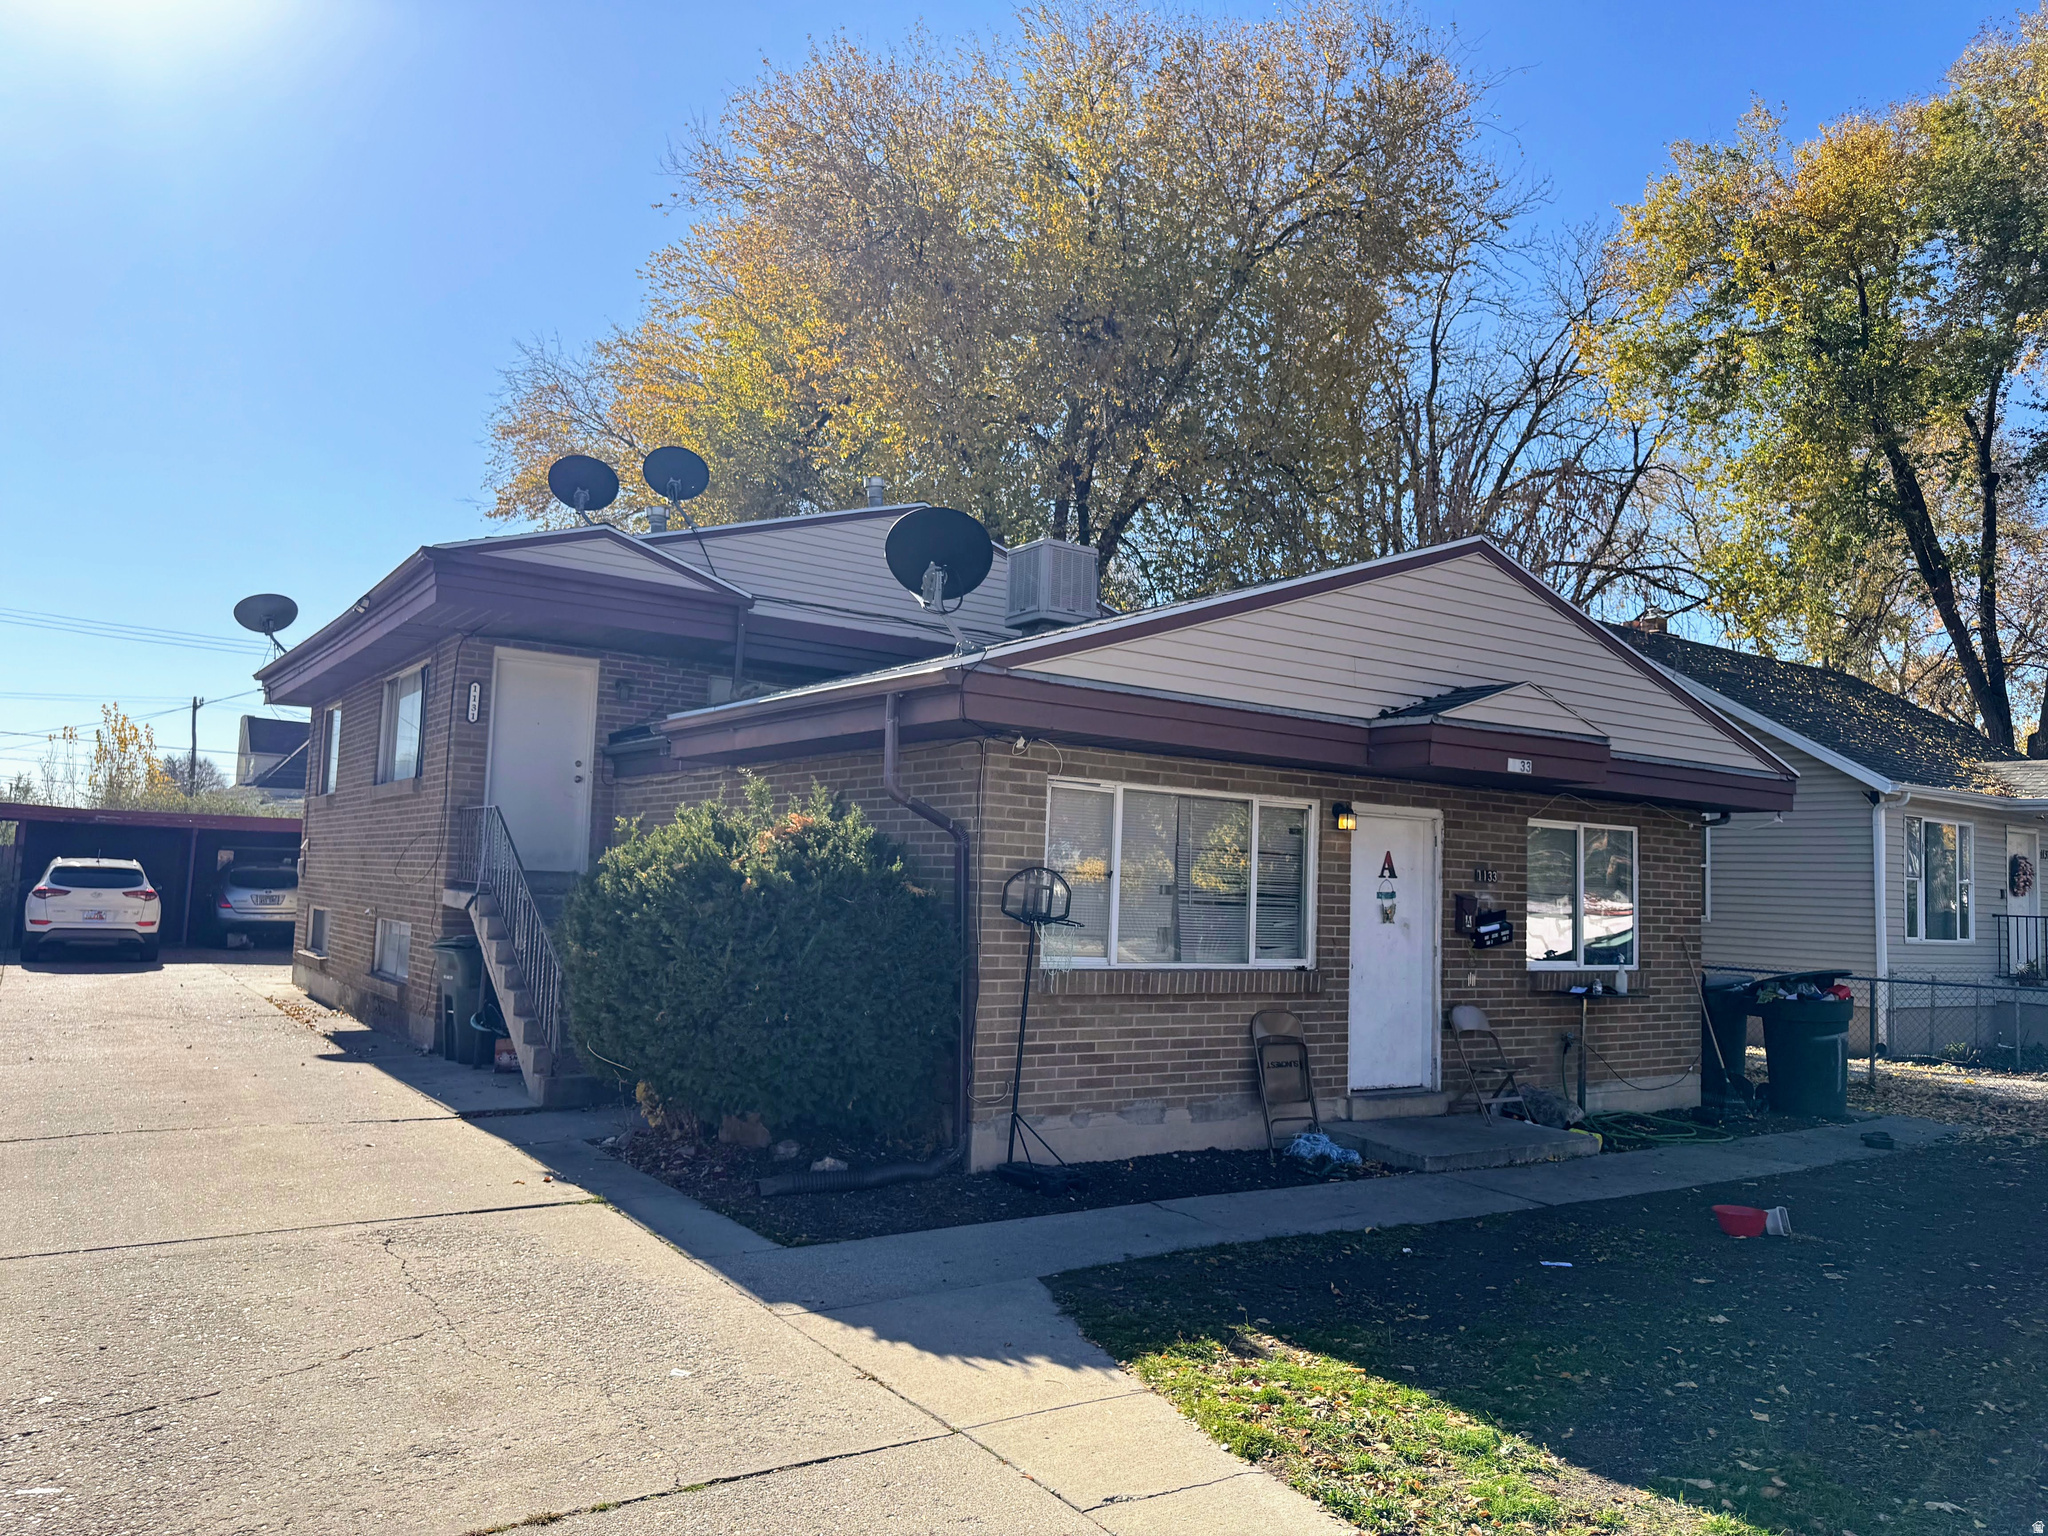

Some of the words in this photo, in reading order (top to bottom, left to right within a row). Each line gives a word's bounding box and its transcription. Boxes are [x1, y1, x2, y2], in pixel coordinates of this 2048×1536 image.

[1520, 760, 1531, 773] 33
[1378, 850, 1398, 879] A
[1476, 869, 1497, 883] 1133
